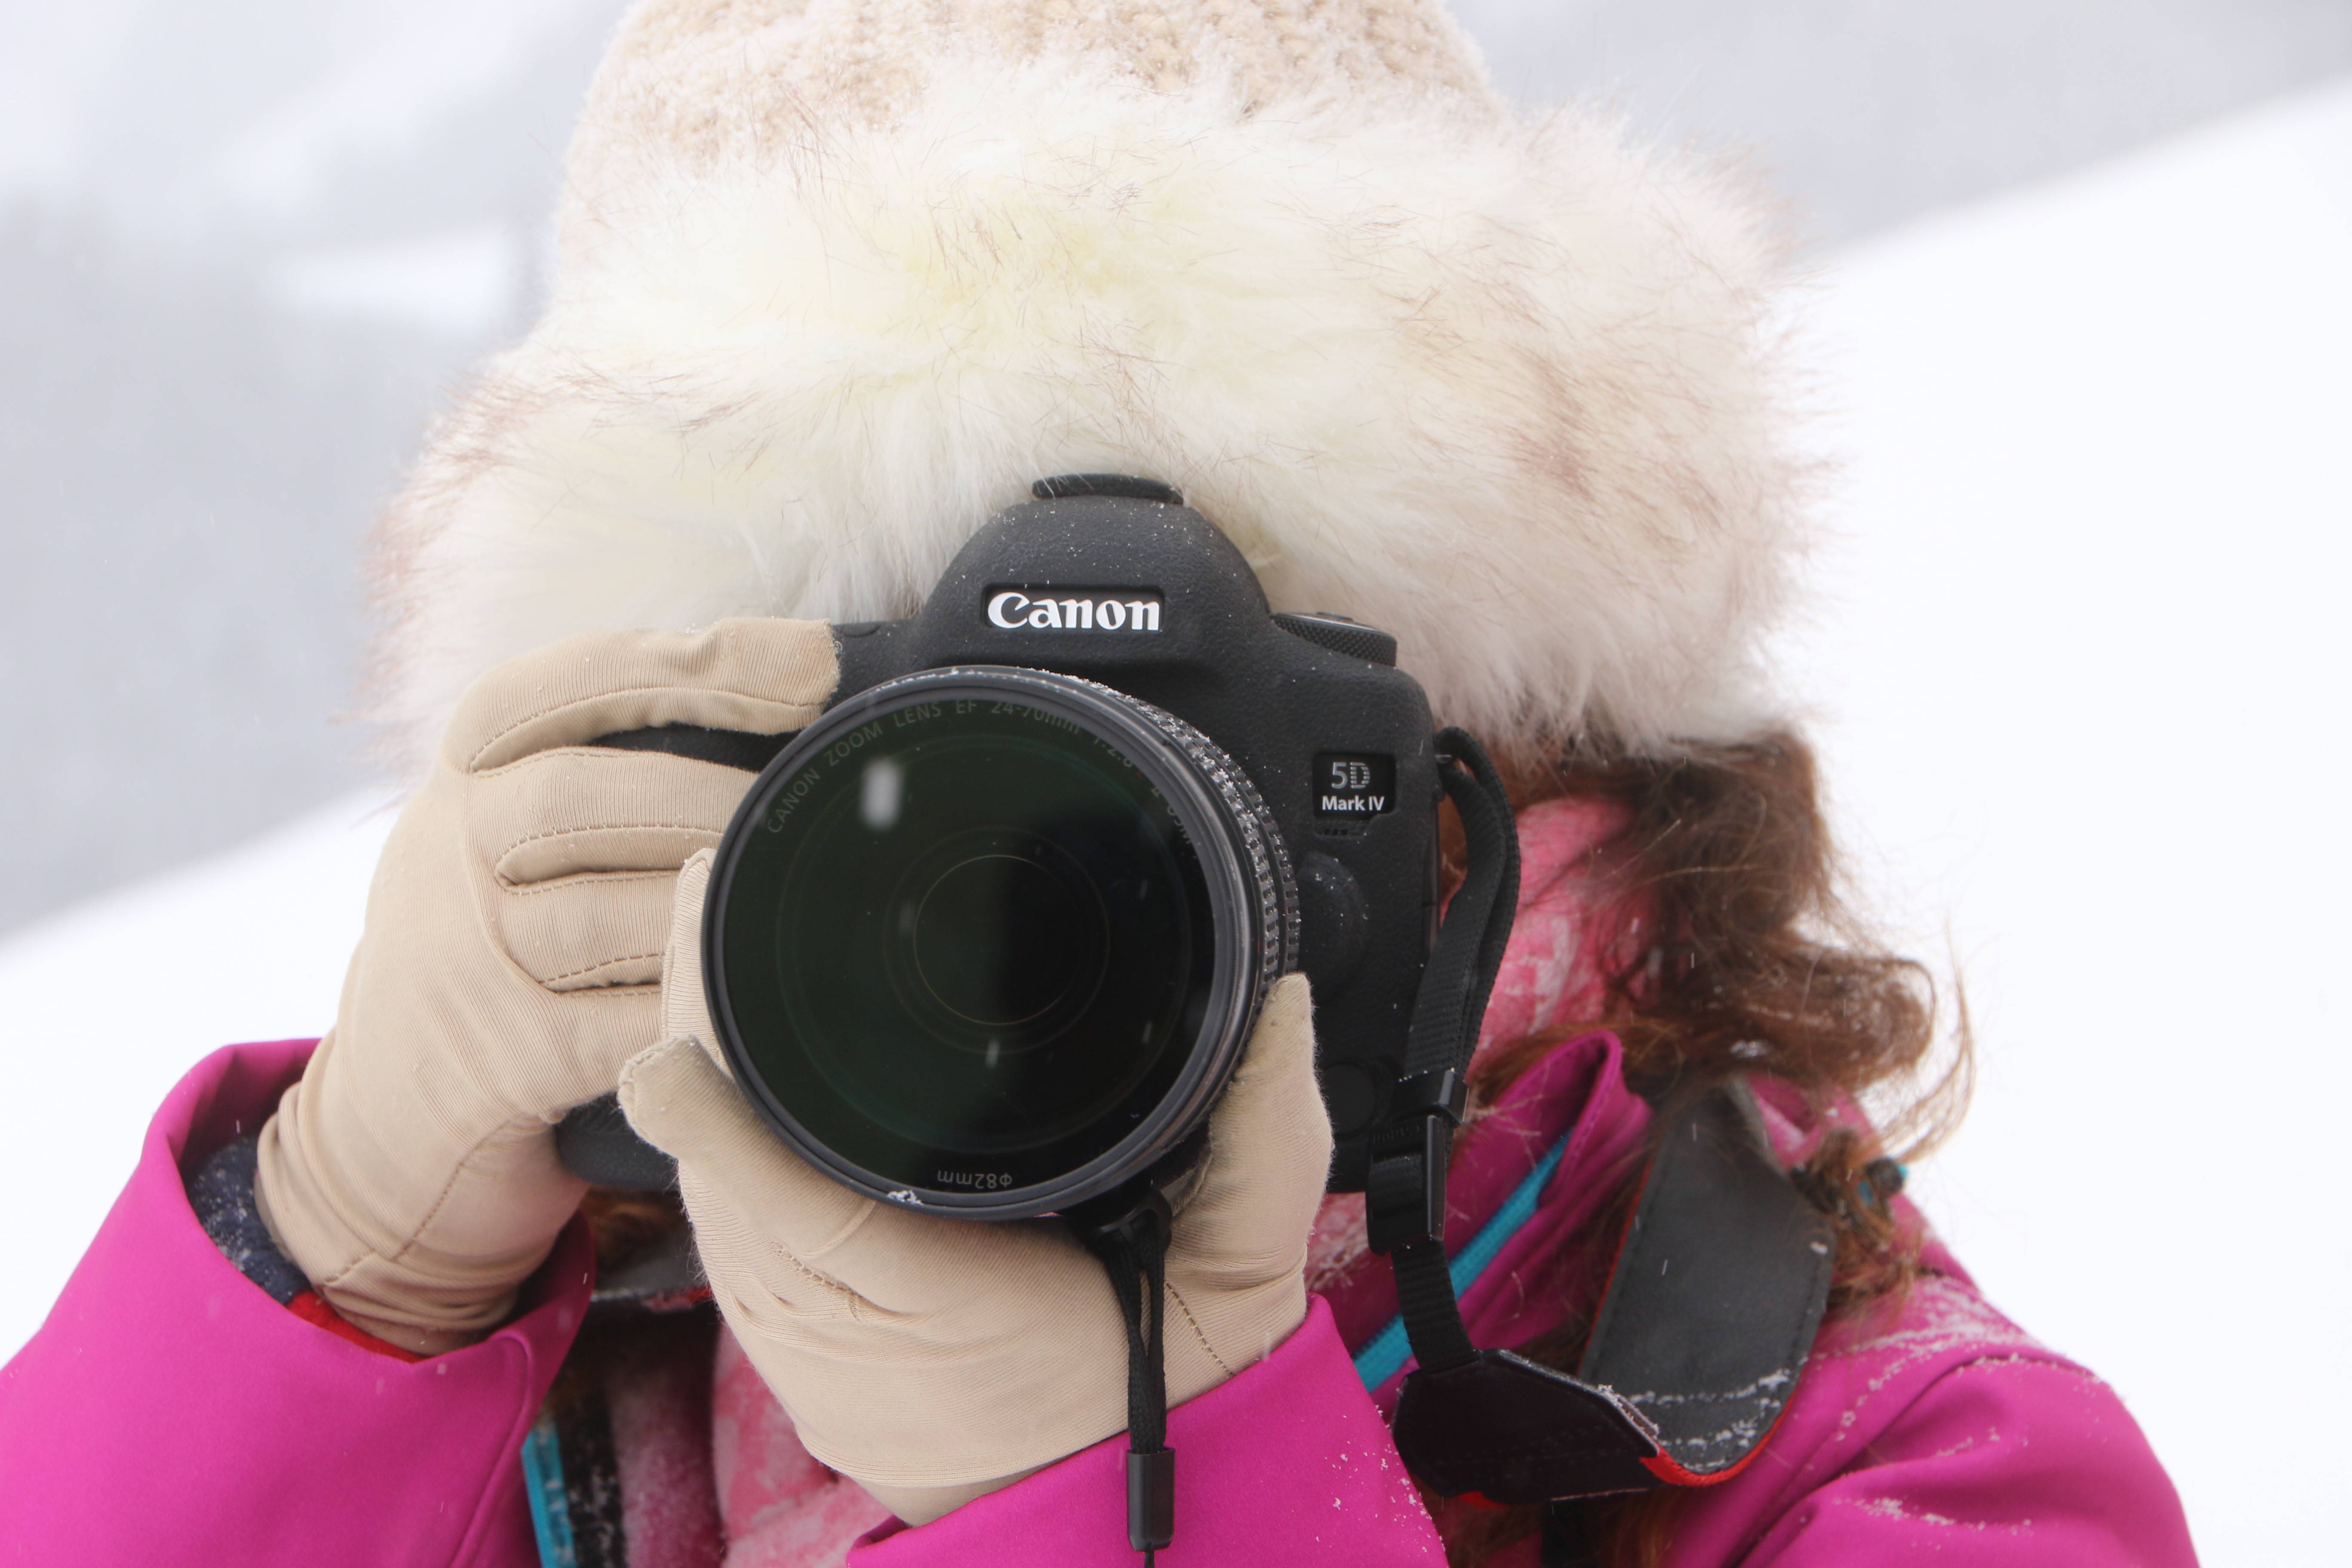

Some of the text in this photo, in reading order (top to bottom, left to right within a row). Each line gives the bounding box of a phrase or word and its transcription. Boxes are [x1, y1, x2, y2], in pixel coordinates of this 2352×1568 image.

[988, 592, 1160, 631] Canon
[767, 767, 821, 833] CANON
[823, 721, 883, 767] ZOOM
[893, 701, 942, 727] LENS
[956, 699, 977, 714] EF
[1332, 762, 1370, 789] 5D
[1322, 795, 1385, 811] Mark IV
